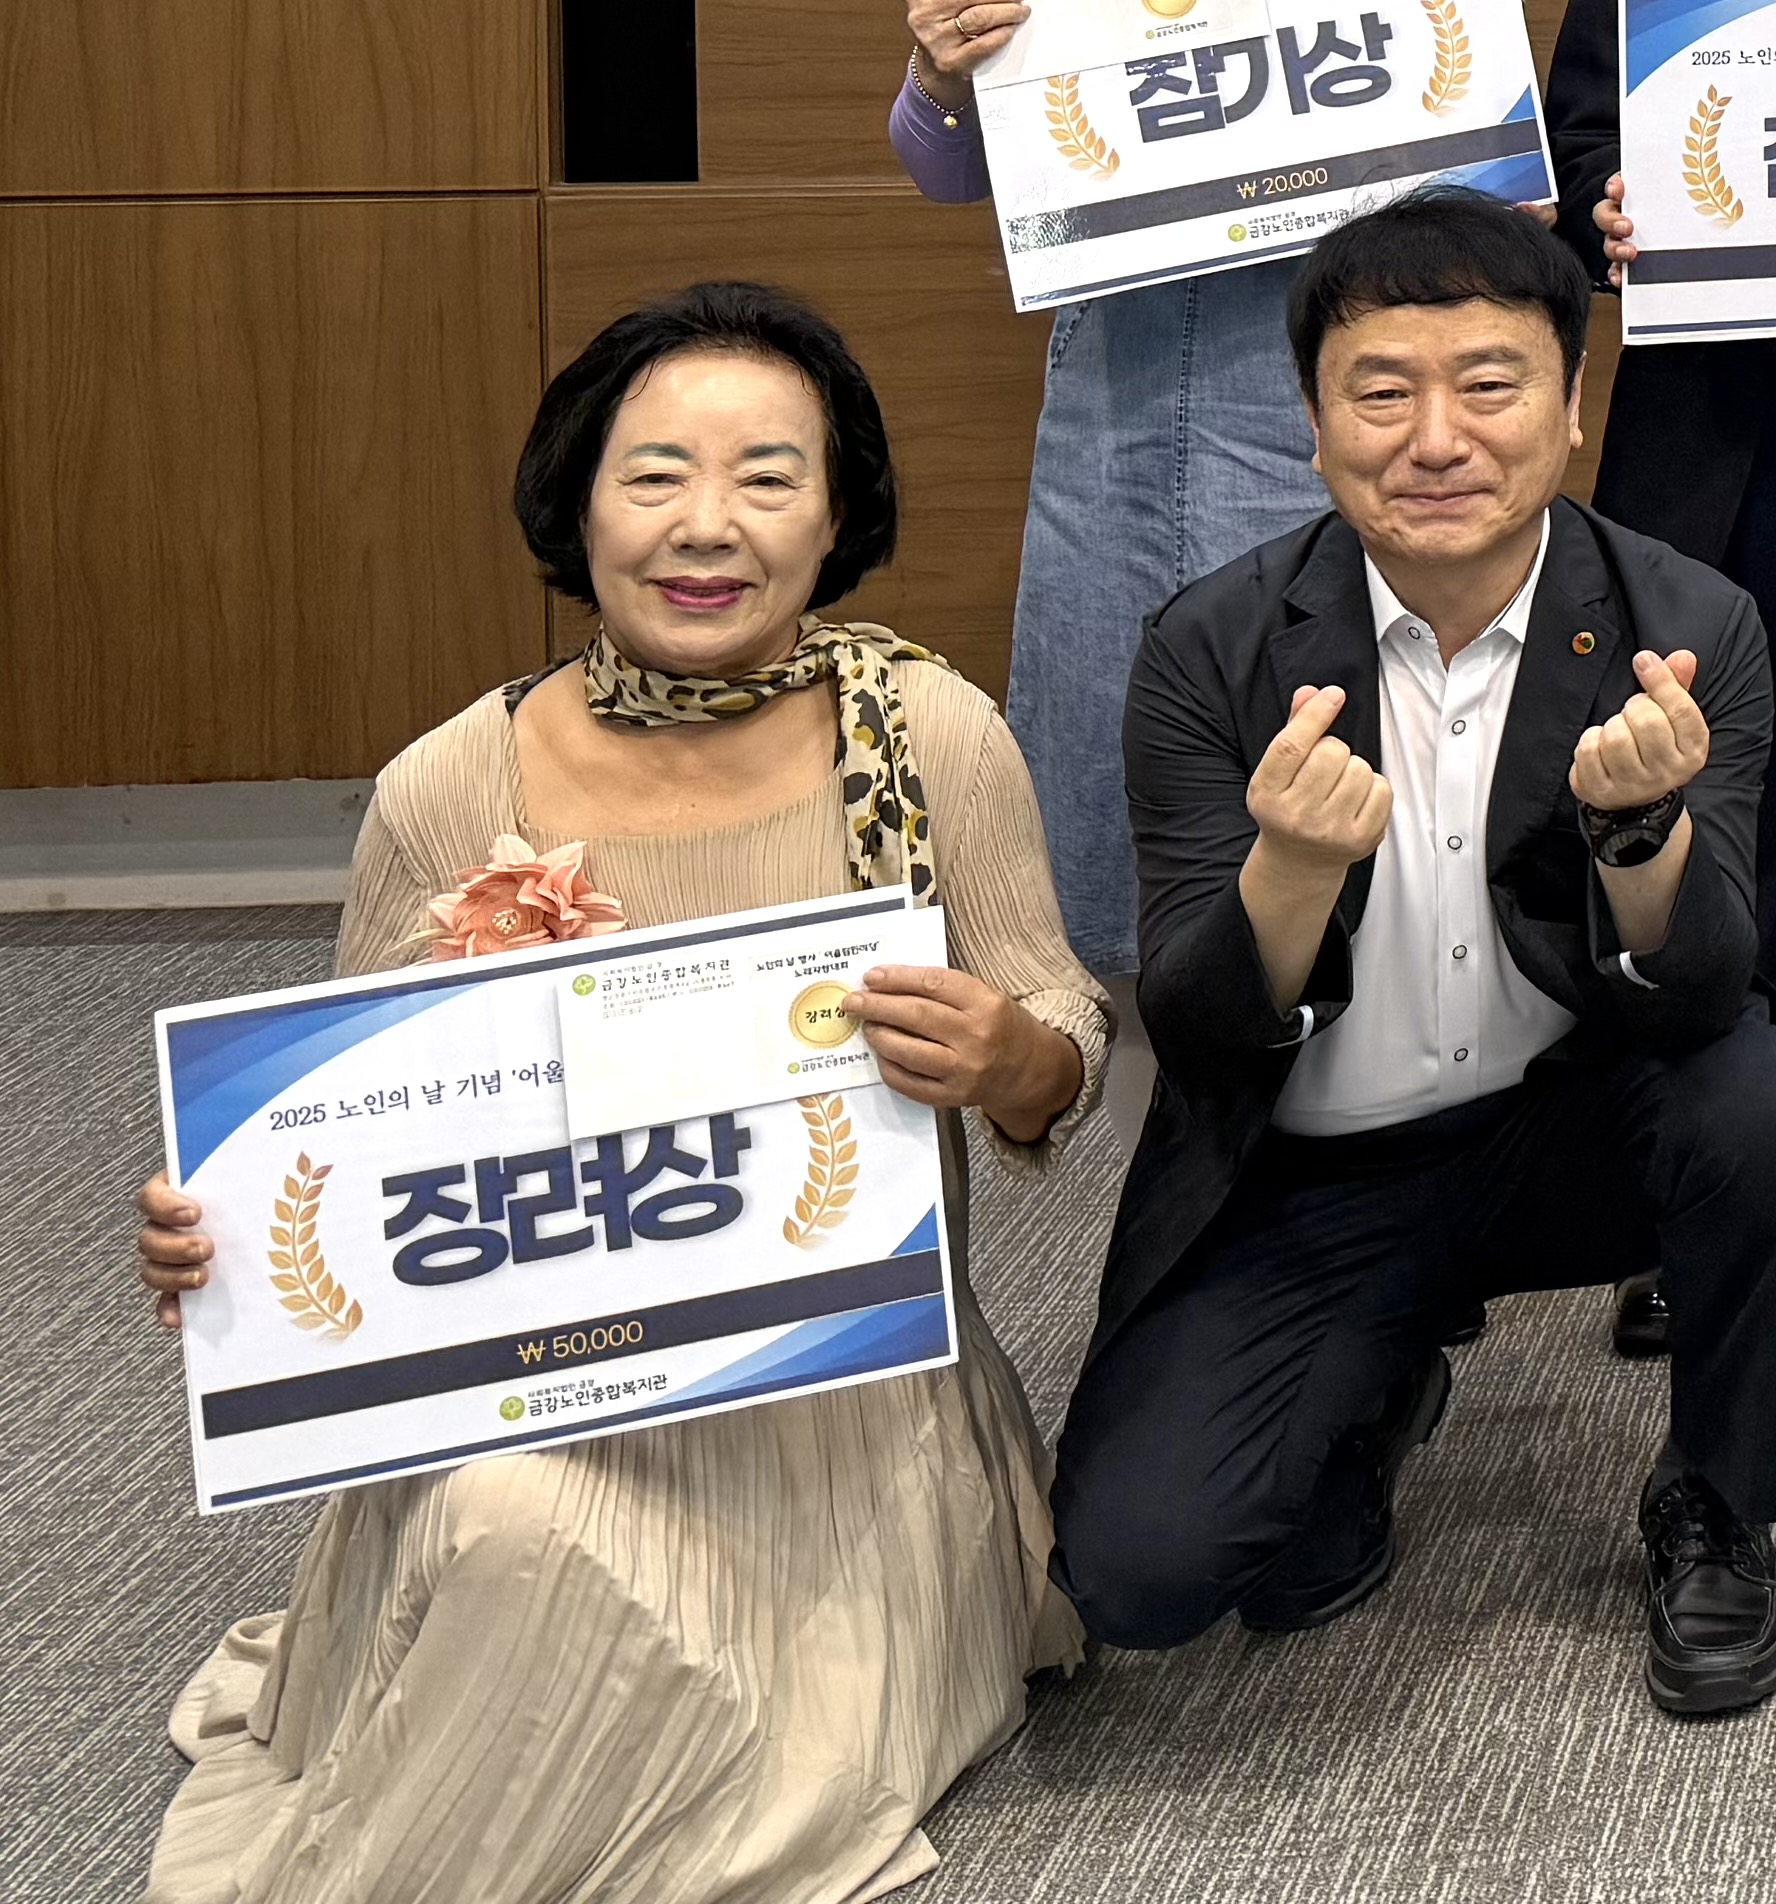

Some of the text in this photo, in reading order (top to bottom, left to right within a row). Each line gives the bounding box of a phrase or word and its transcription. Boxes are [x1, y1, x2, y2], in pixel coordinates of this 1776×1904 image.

[1125, 11, 1393, 143] 참가상
[1691, 49, 1731, 67] 2025
[269, 1102, 327, 1132] 2025
[335, 1085, 410, 1121] 노인의
[420, 1079, 447, 1106] 날
[457, 1069, 501, 1099] 기념
[381, 1111, 751, 1287] 장려상
[552, 1320, 644, 1358] 50,000
[528, 1373, 668, 1417] 금강노인종합복지관
